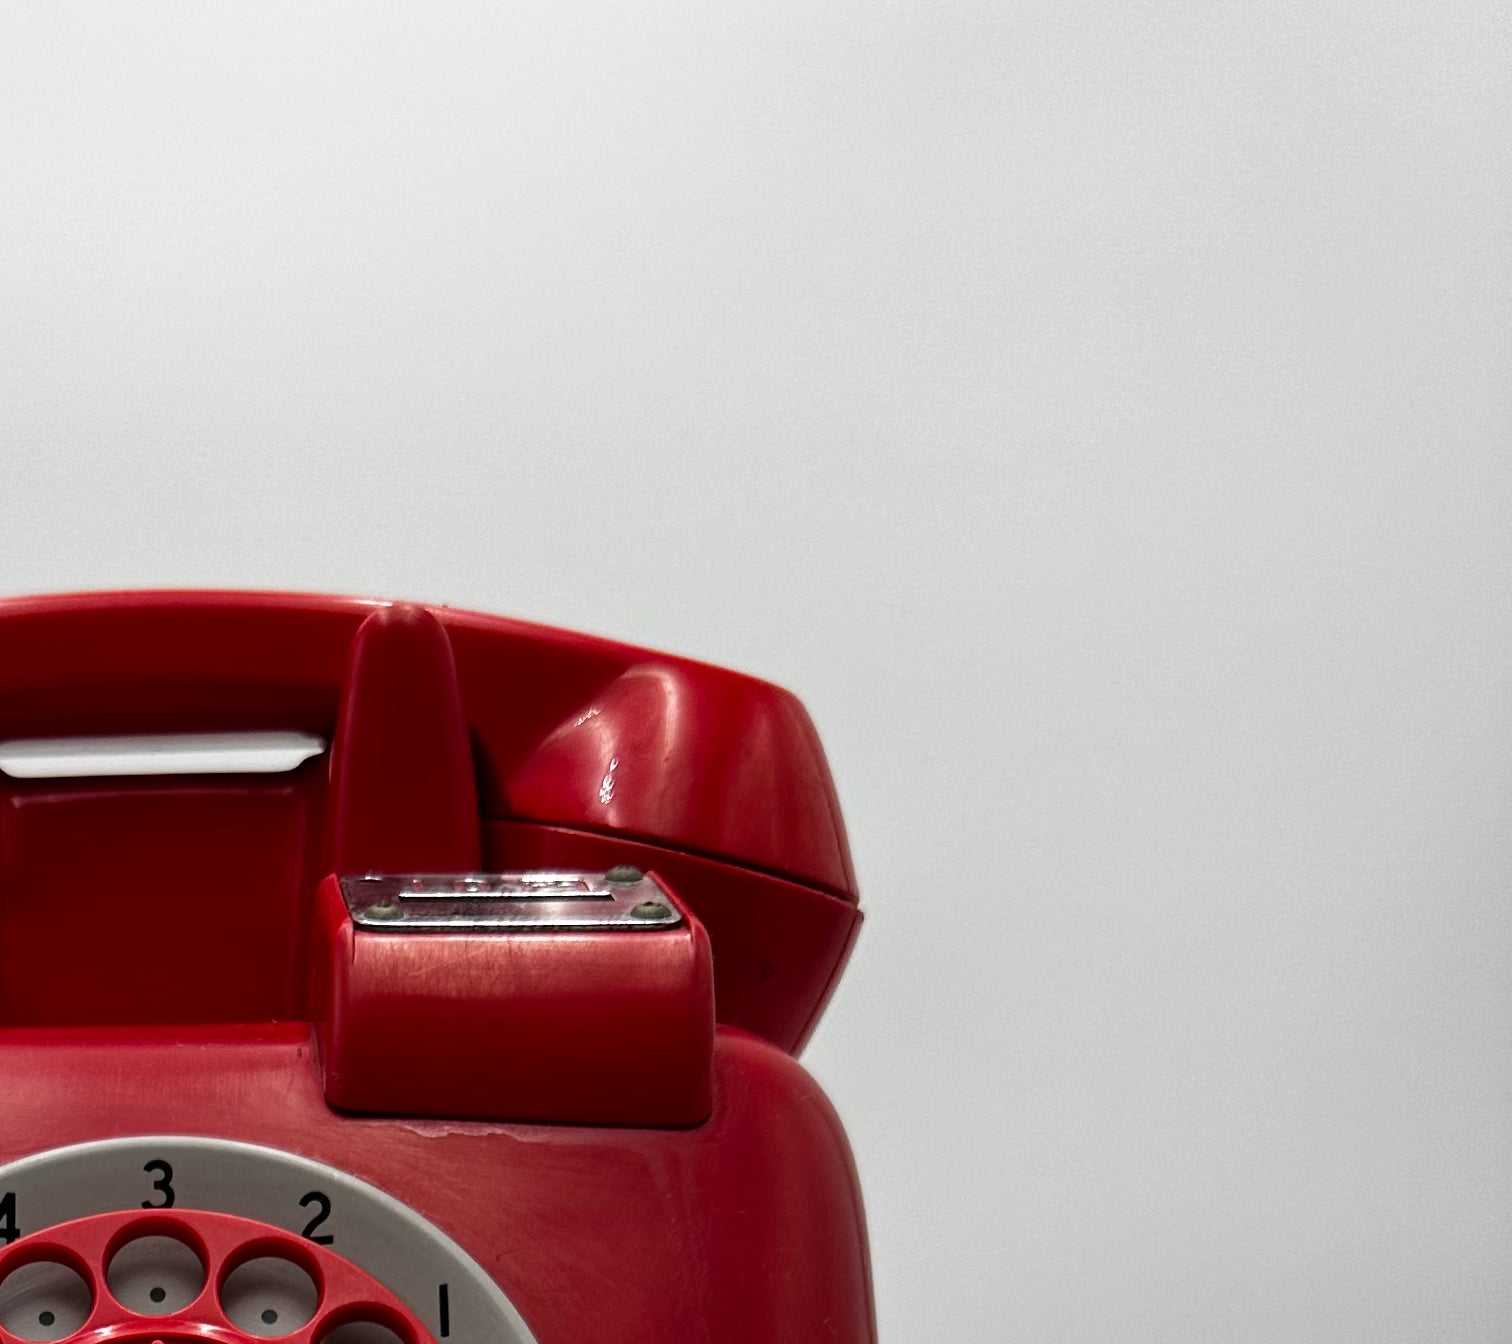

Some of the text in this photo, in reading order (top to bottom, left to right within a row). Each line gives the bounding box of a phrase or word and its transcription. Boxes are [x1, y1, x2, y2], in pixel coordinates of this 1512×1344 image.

[141, 1158, 176, 1209] 3
[297, 1189, 335, 1246] 2
[438, 1282, 451, 1338] 1
